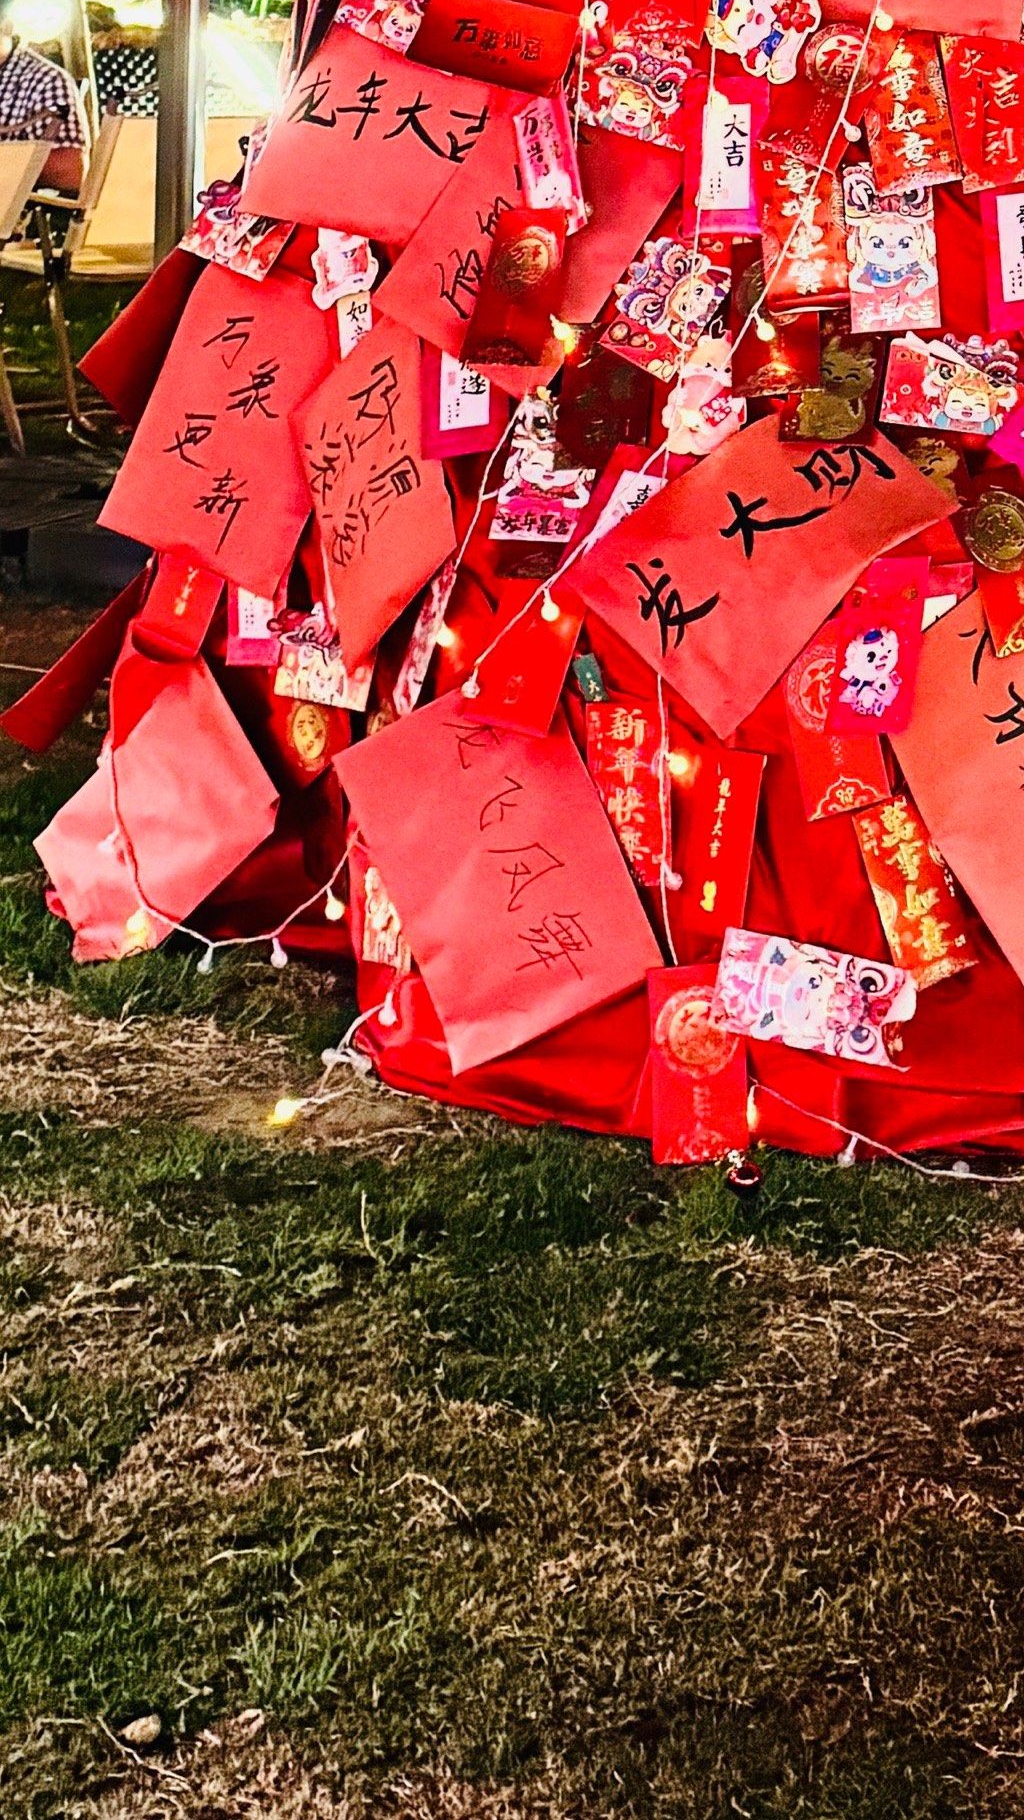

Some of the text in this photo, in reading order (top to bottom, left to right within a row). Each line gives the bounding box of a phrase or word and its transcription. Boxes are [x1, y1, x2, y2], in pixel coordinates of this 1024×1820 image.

[288, 66, 491, 165] 龙年大吉
[723, 114, 749, 169] 大吉
[625, 445, 897, 659] 发大财
